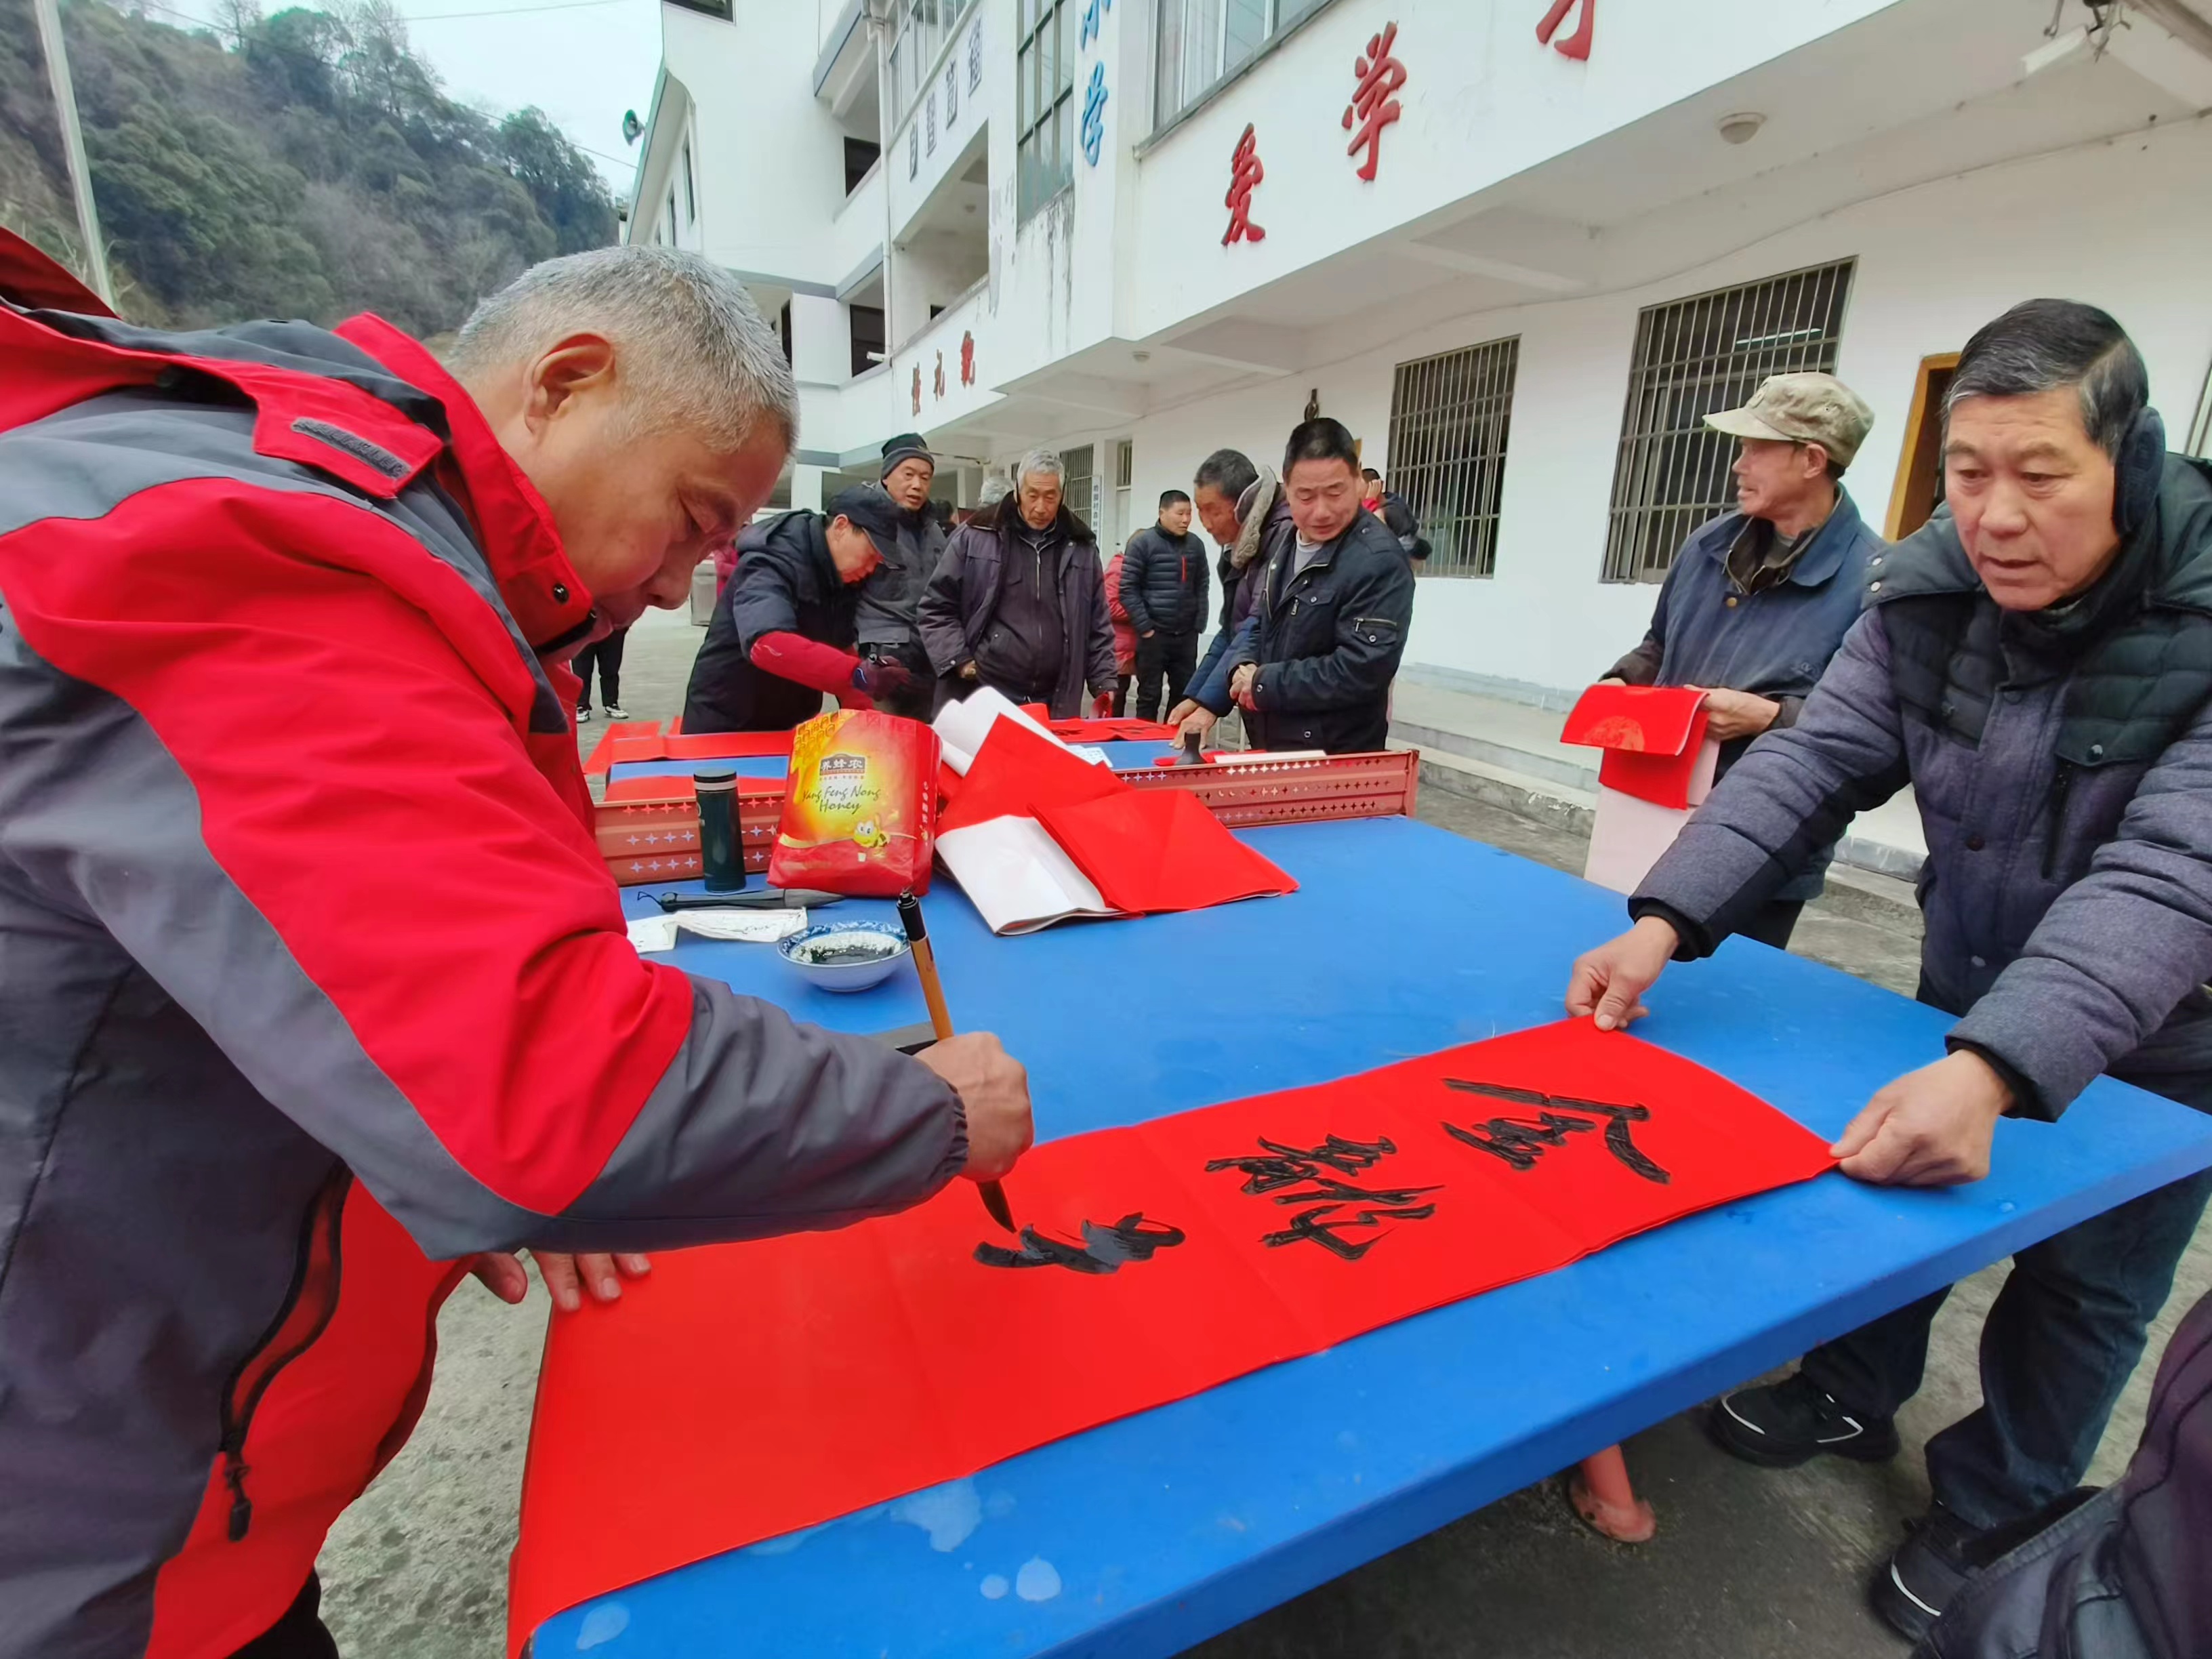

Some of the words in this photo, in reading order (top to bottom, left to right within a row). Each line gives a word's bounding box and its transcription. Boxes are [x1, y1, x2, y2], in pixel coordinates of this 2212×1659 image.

[802, 789, 822, 803] Yang
[824, 785, 848, 801] Feng
[850, 784, 881, 801] Nong
[819, 799, 861, 815] Honey
